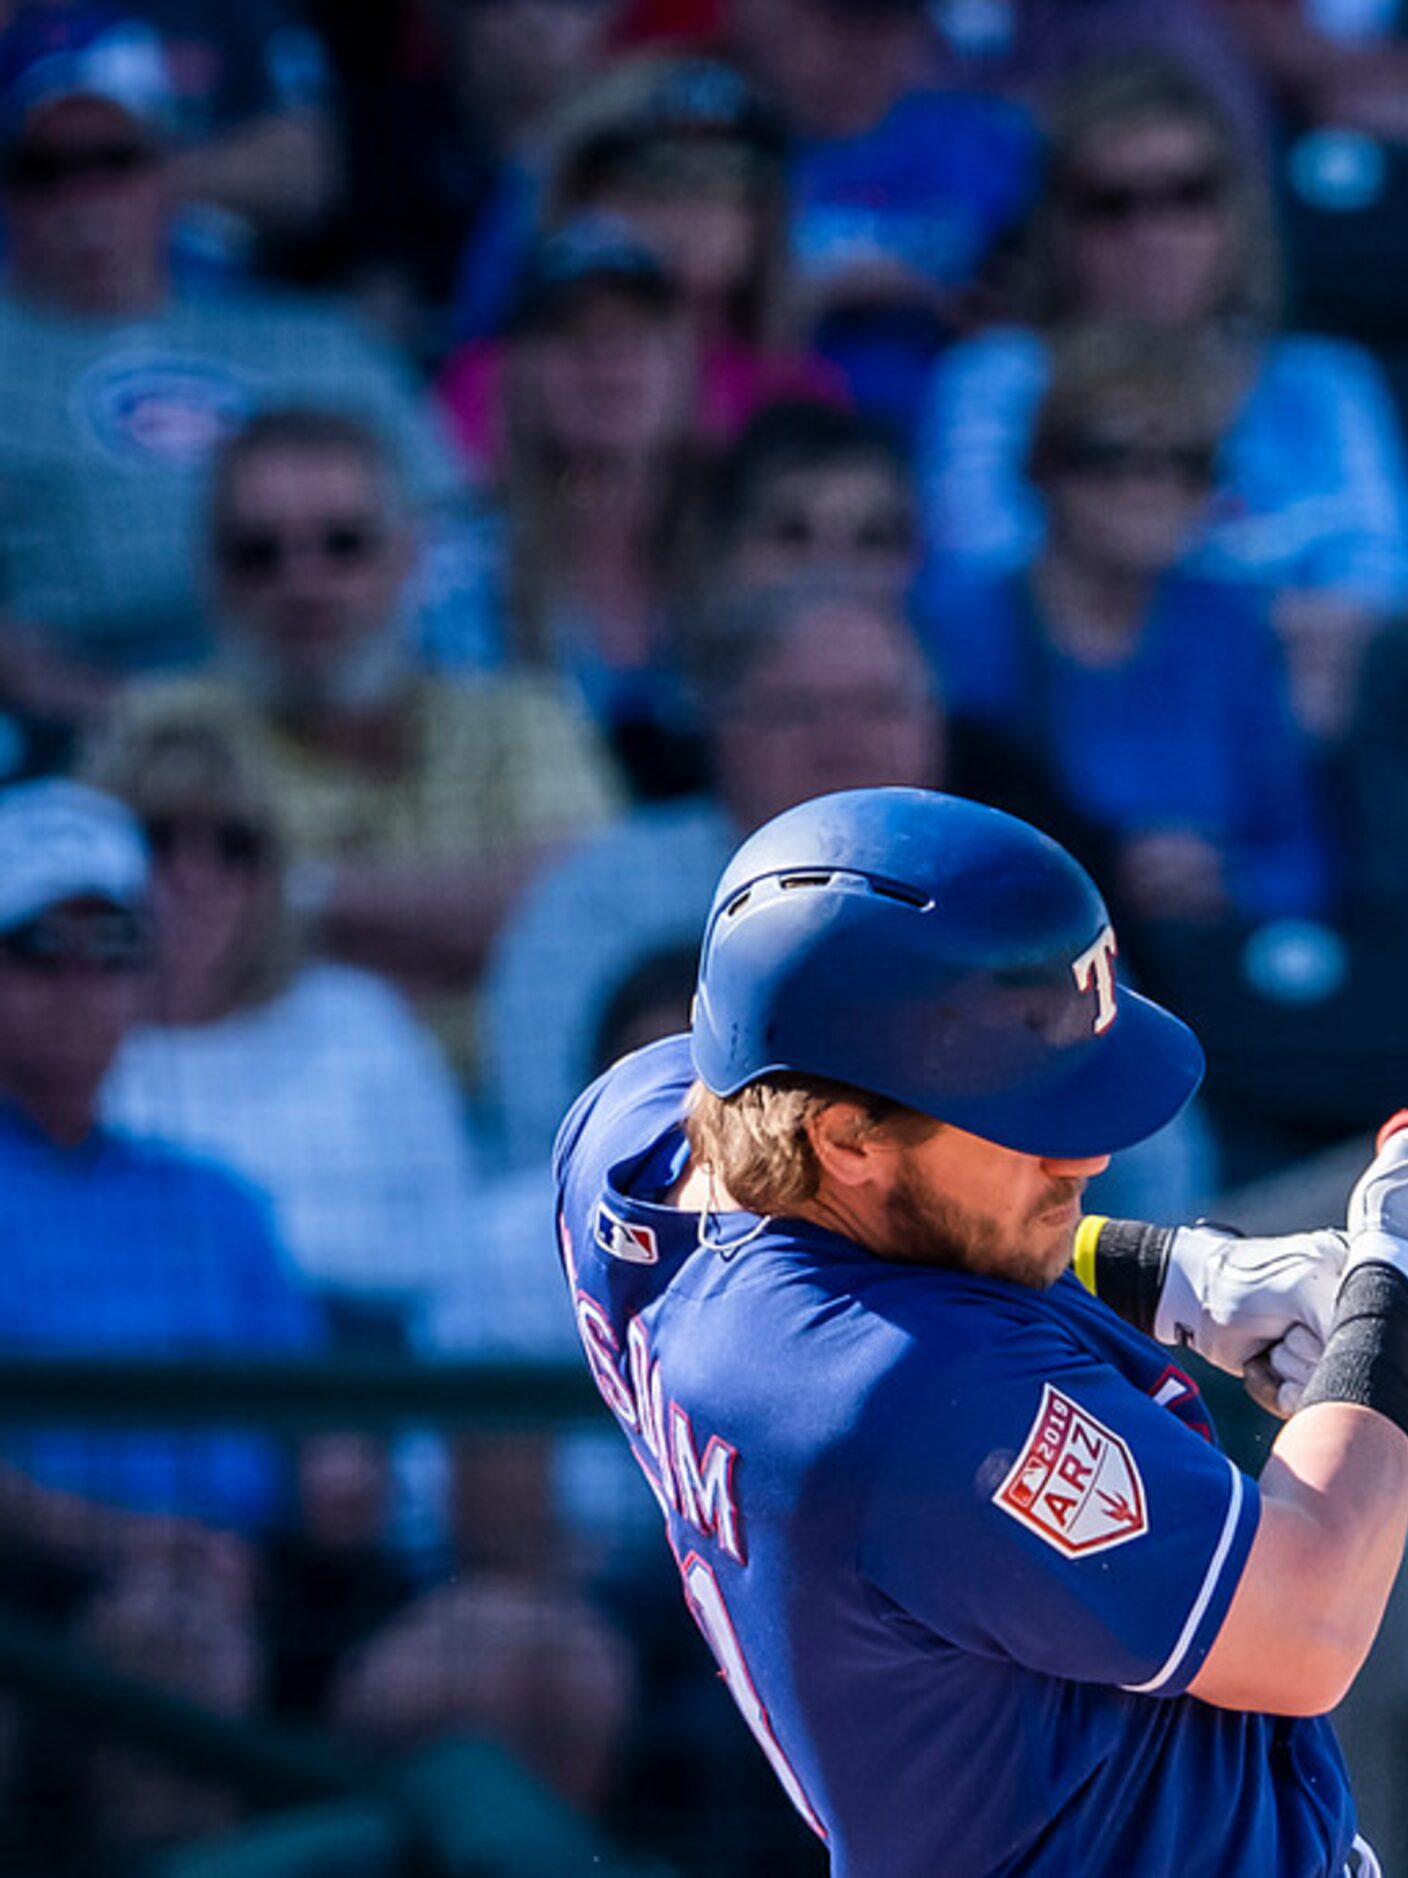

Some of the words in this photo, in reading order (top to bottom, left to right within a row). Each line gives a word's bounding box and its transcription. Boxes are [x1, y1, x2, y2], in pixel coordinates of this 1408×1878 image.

[1071, 924, 1118, 1037] T
[1036, 1398, 1069, 1462] 2019
[1044, 1421, 1102, 1527] ARZ
